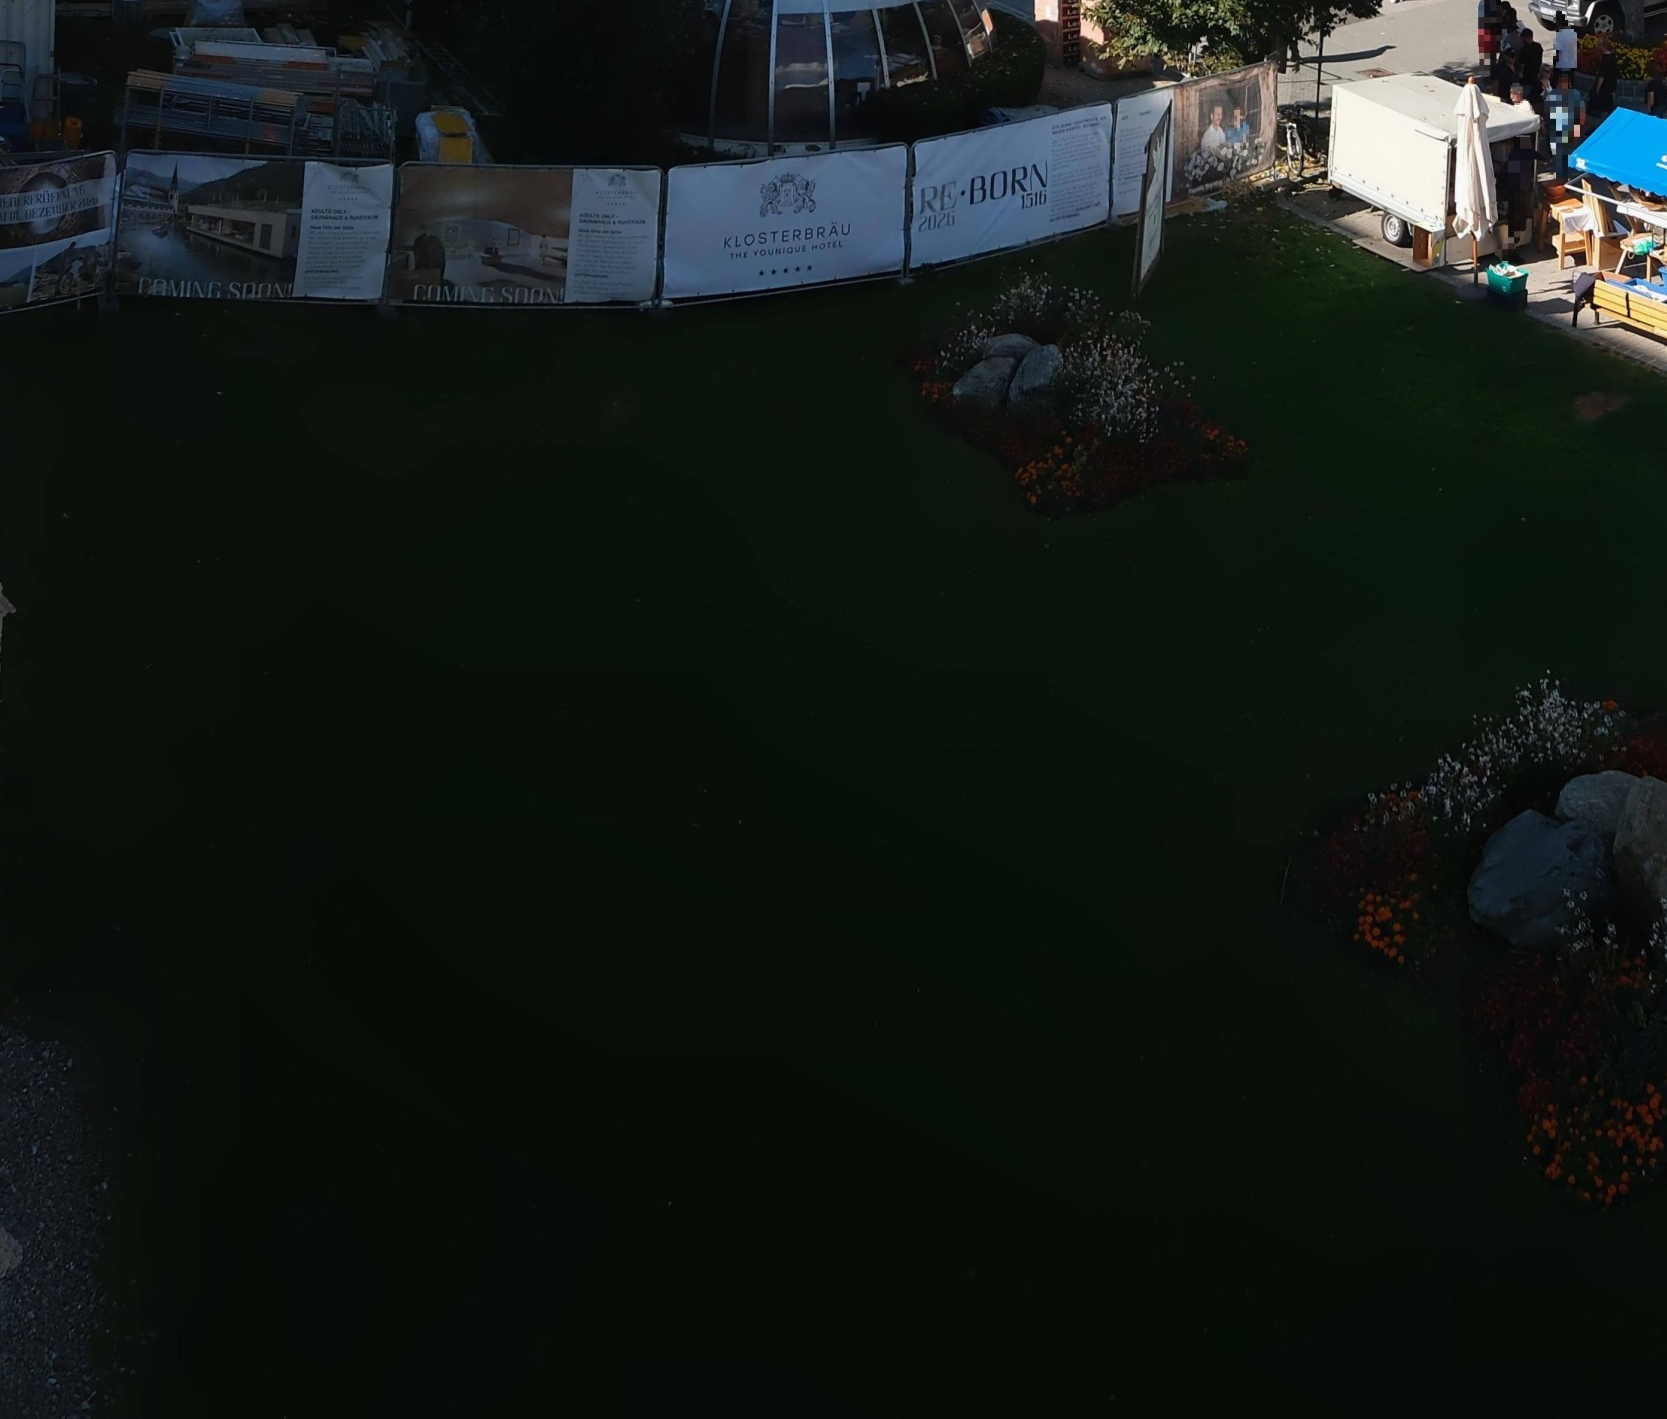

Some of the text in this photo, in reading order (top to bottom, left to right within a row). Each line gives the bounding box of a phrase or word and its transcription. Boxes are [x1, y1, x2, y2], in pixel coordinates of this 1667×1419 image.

[1020, 189, 1047, 210] 1516
[918, 211, 955, 232] 2026
[723, 222, 851, 249] KLOSTERBRÄU
[729, 240, 844, 260] THE YOUNIQUE HOTEL
[138, 278, 221, 298] COMING
[413, 284, 494, 303] COMING
